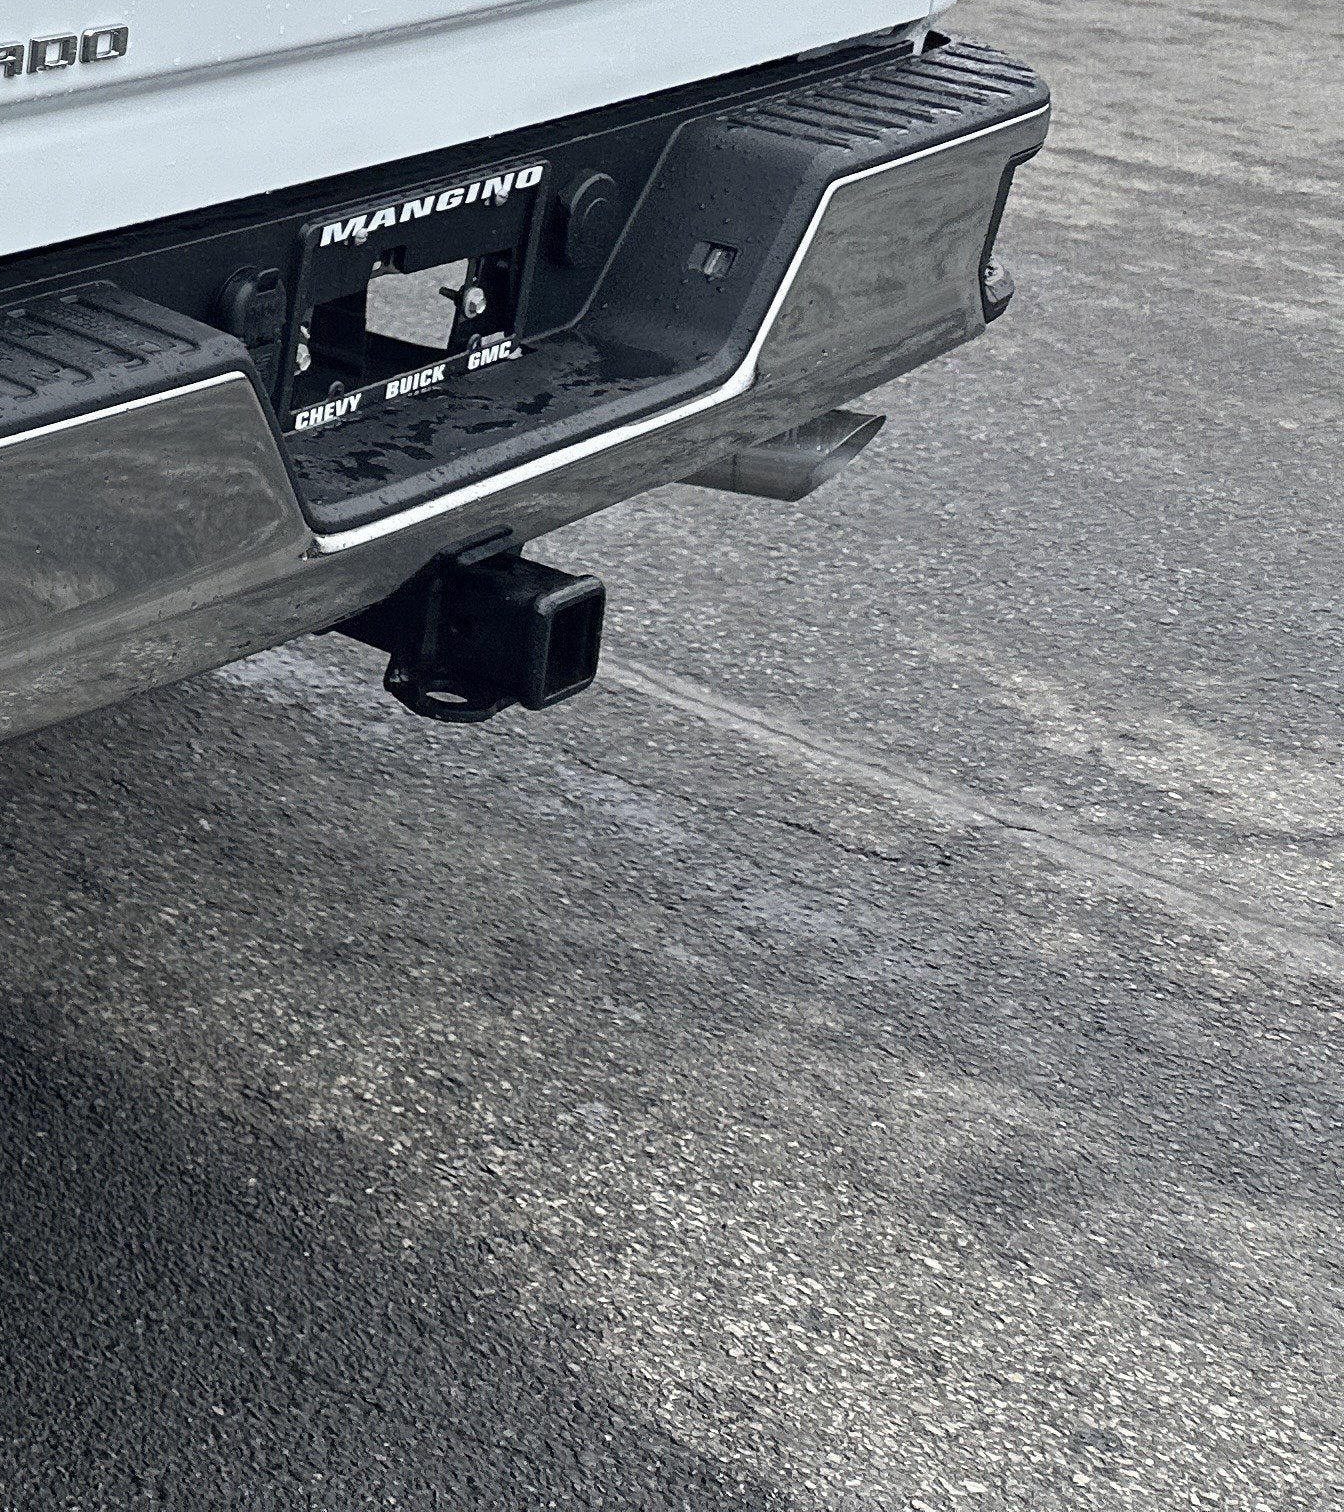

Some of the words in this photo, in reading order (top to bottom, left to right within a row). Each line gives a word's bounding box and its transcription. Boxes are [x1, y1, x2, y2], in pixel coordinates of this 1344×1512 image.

[319, 164, 544, 248] MANGINO
[294, 392, 363, 431] CHEVY
[385, 363, 447, 401] BUICK
[468, 340, 512, 371] GMC
